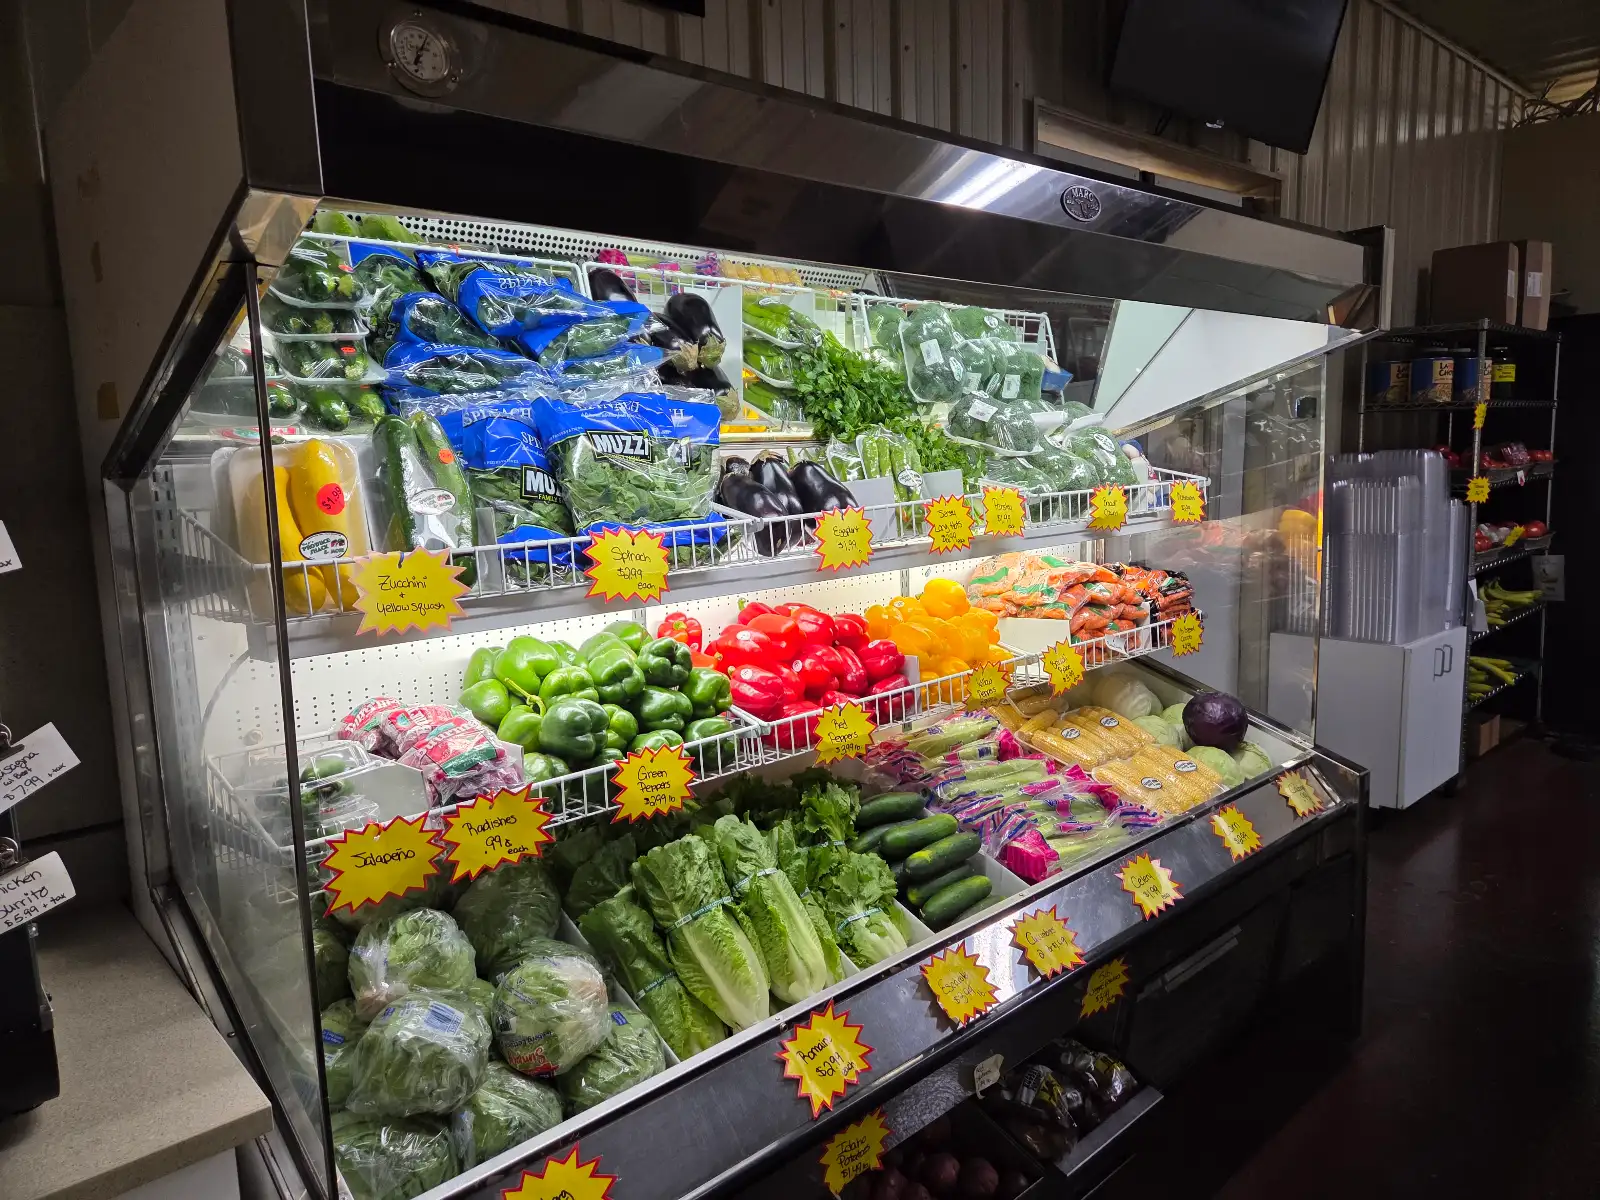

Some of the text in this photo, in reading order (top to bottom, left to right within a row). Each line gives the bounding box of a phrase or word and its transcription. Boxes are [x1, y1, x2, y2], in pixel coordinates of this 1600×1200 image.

[1071, 187, 1094, 202] MARC
[322, 486, 343, 511] $1.99
[611, 546, 652, 565] Spinach
[377, 575, 428, 591] Zucchini
[828, 731, 859, 745] Peppers
[637, 765, 668, 782] Green
[637, 780, 671, 794] Peppers
[461, 814, 518, 837] Radishes
[507, 845, 530, 855] each
[350, 848, 416, 869] Jalapeño
[1130, 872, 1156, 889] Celery
[50, 892, 67, 905] tax
